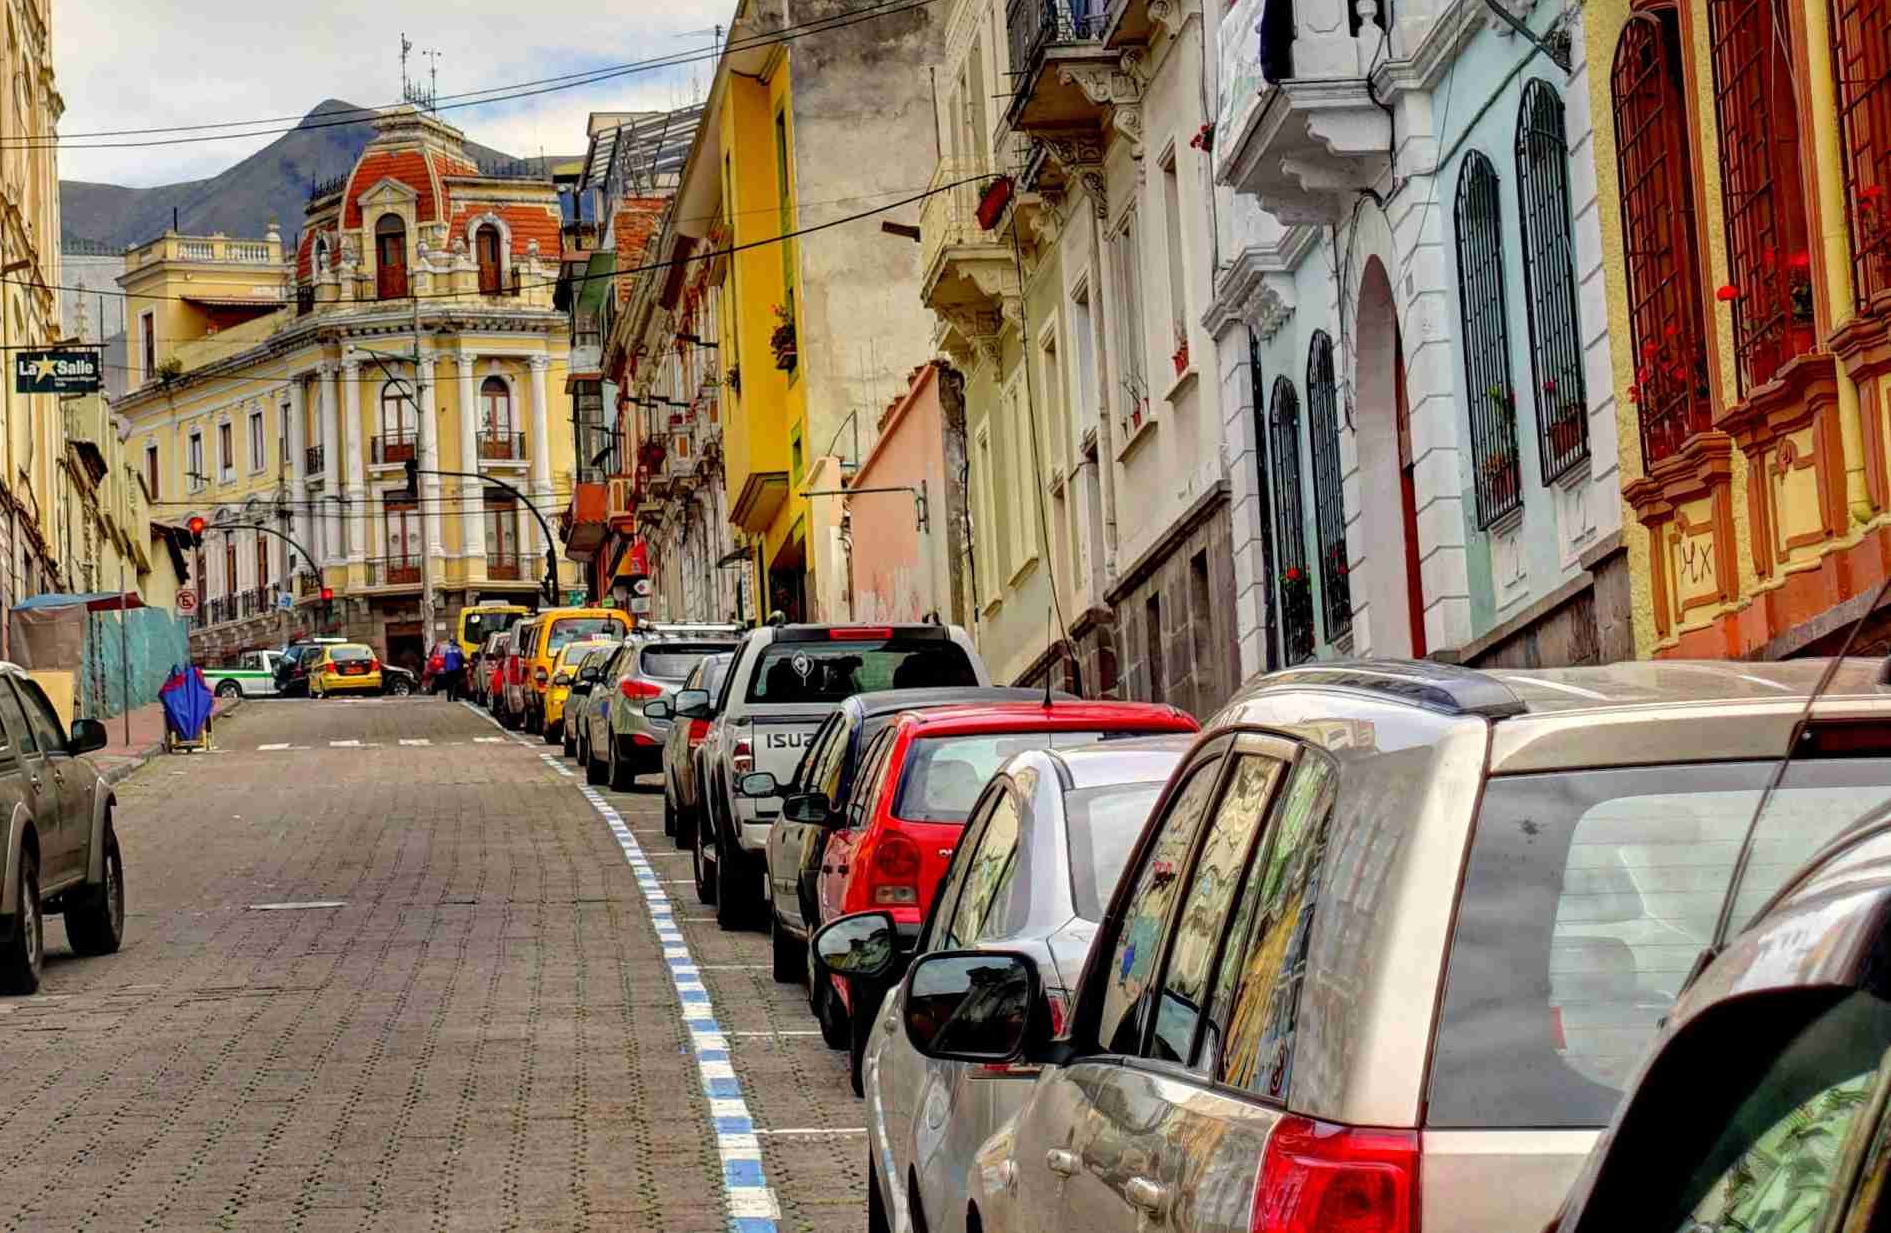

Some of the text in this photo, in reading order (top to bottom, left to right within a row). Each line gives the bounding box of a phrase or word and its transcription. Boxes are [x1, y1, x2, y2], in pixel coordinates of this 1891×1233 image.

[19, 360, 95, 375] La Salle
[767, 733, 816, 748] ISUZ
